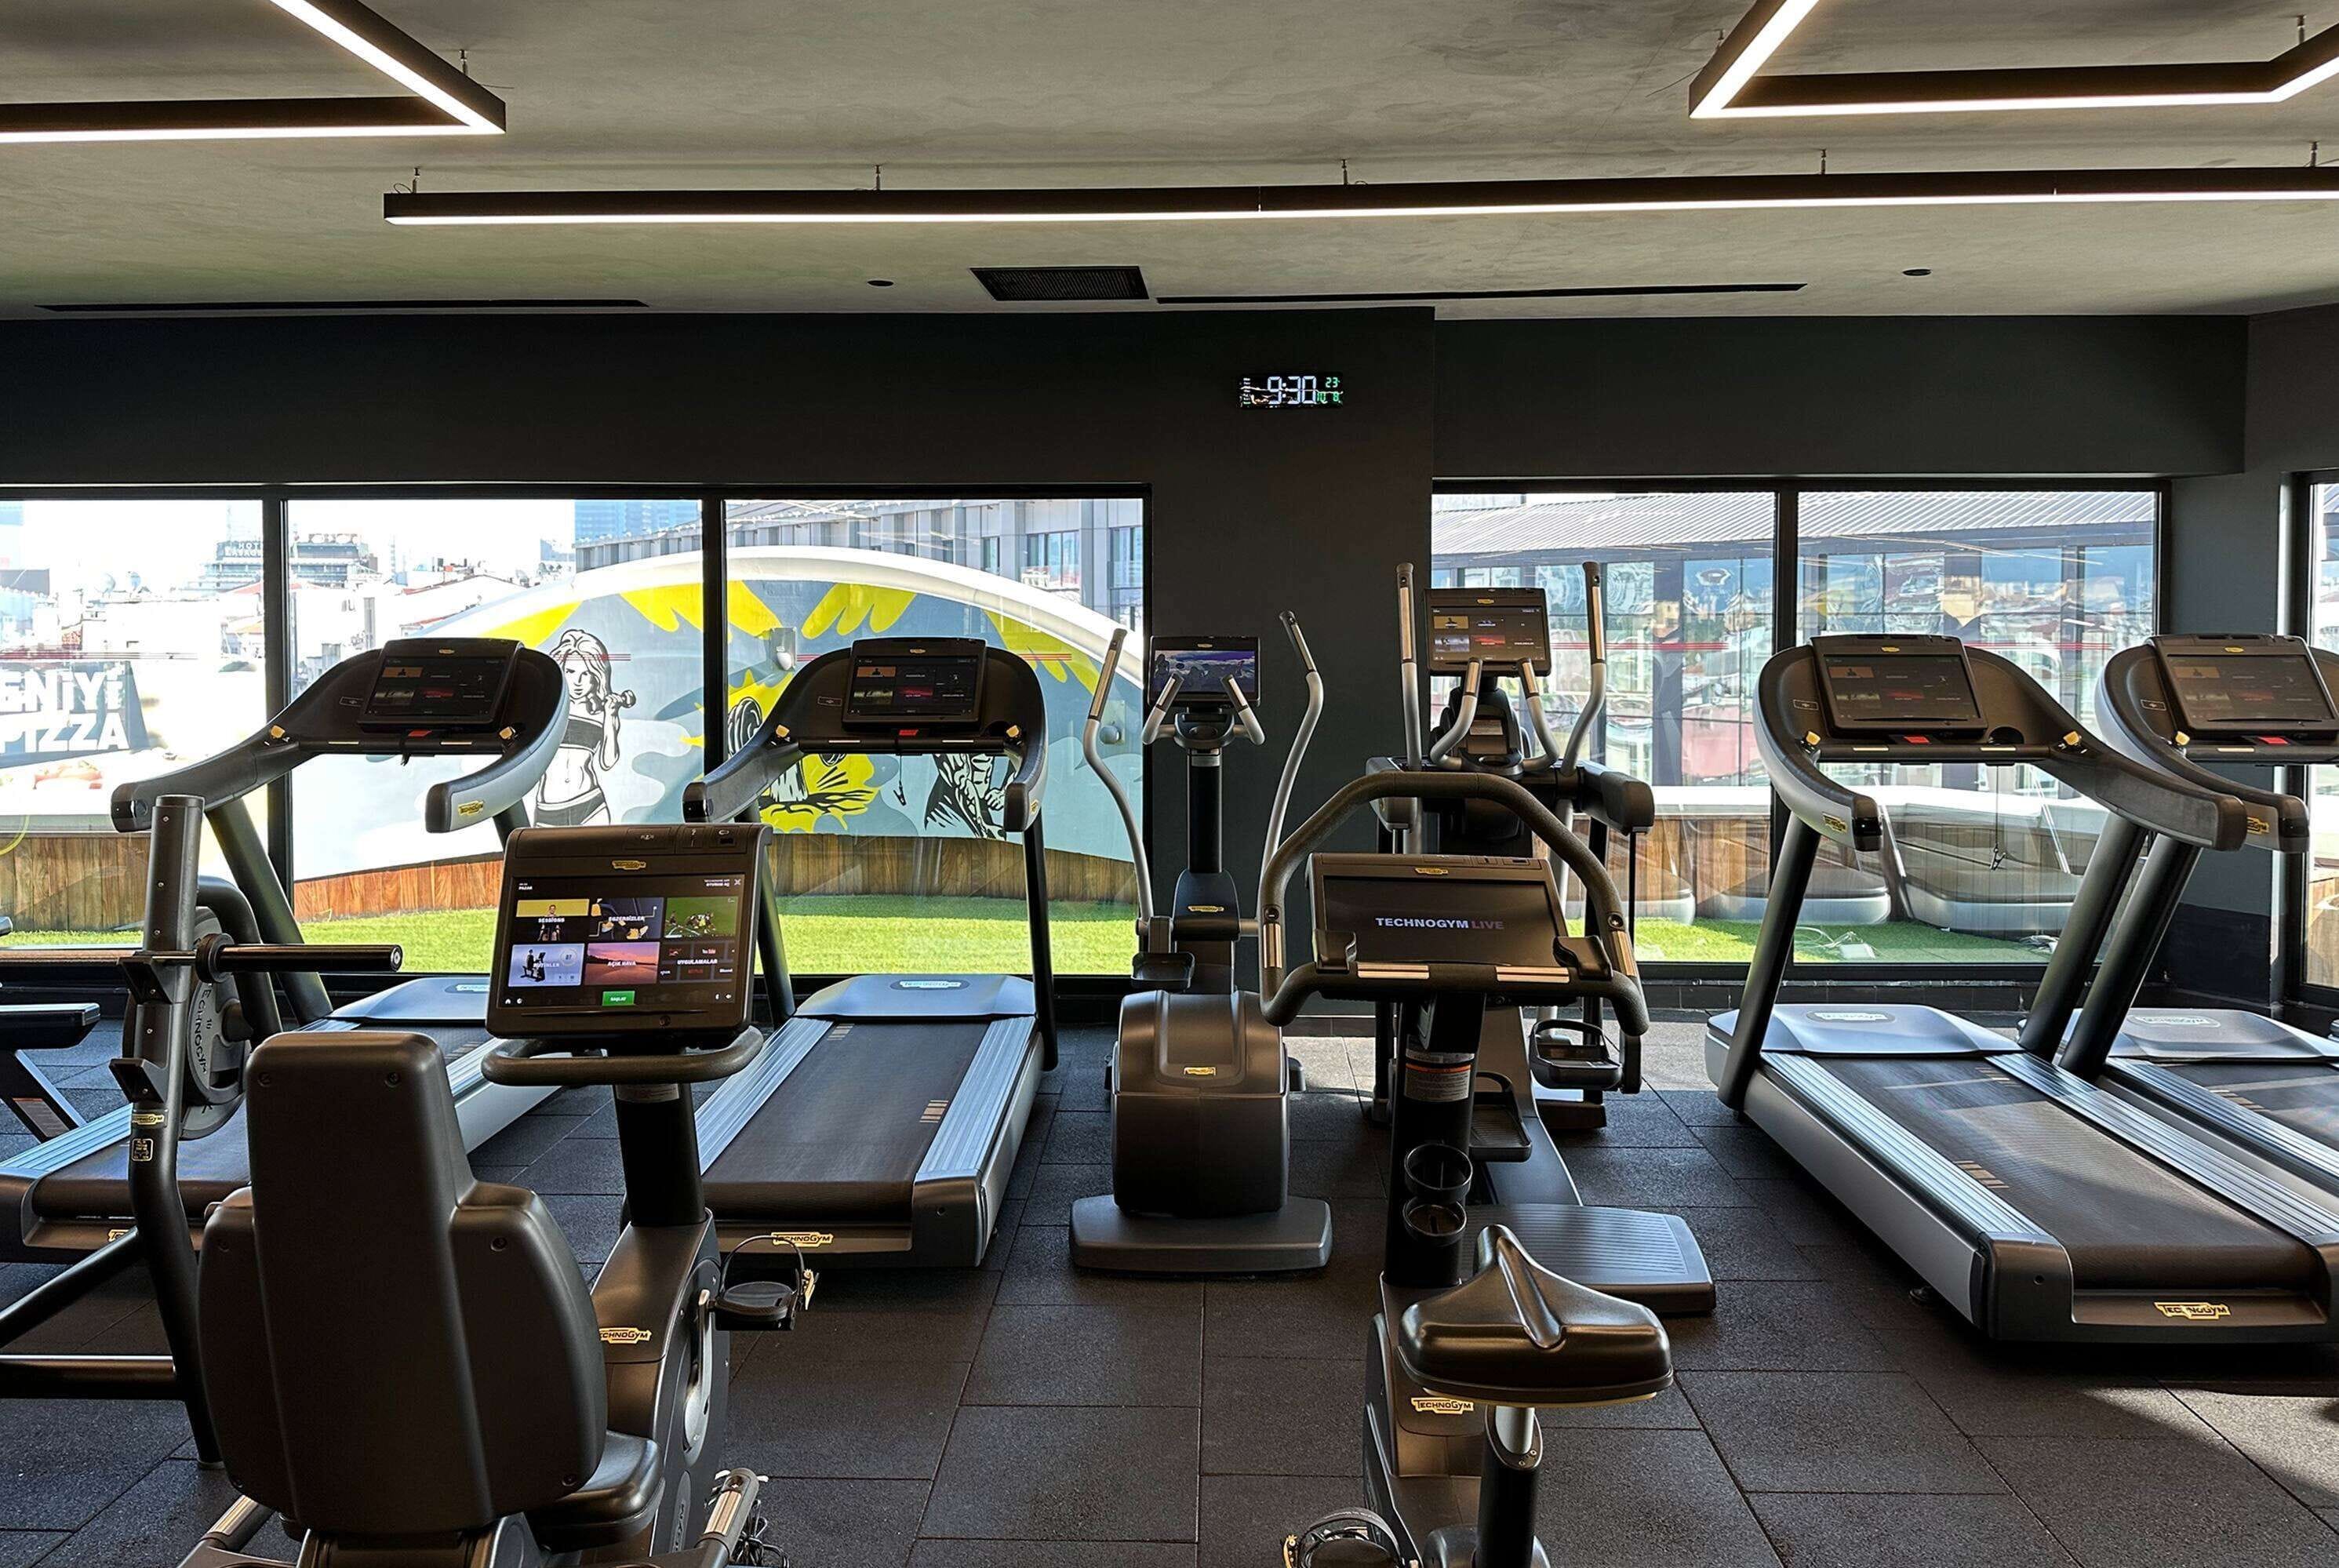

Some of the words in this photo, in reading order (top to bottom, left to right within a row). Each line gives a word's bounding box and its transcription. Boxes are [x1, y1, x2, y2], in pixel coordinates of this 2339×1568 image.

[1267, 376, 1316, 405] 9:30
[1375, 917, 1469, 929] TECHNOGYM
[1471, 921, 1504, 930] LIVE
[1412, 1399, 1473, 1413] TECHNOGYM
